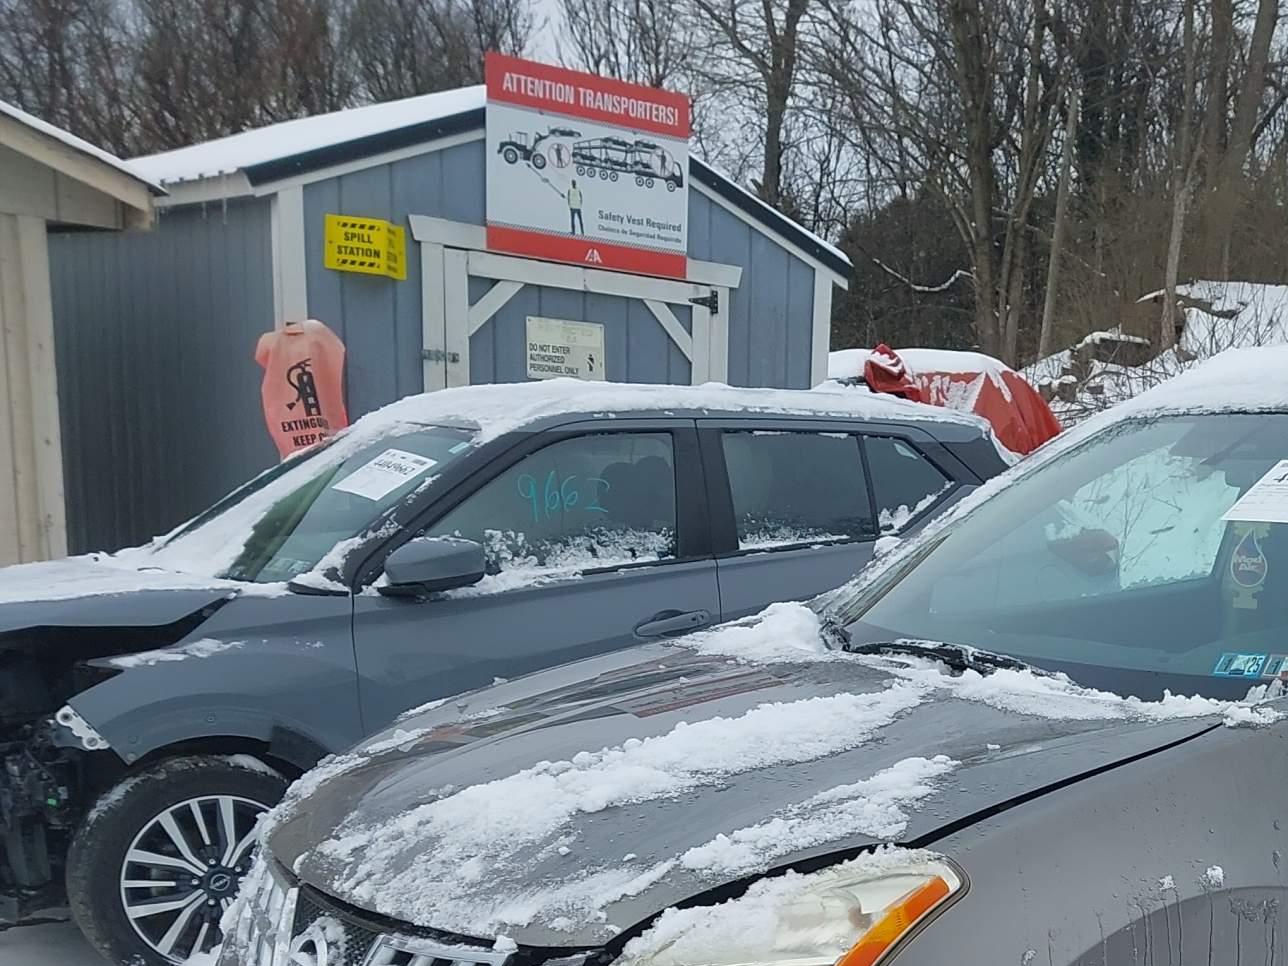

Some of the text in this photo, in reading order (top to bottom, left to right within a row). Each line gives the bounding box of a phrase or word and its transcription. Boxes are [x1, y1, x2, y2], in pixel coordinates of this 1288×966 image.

[502, 72, 679, 126] ATTENTION TRANSPORTERS!
[598, 210, 682, 232] Safety Vest Required
[343, 231, 373, 244] SPILL
[336, 244, 381, 259] STATION
[529, 342, 571, 355] DO NOT ENTER
[529, 353, 565, 364] AUTHORIZED
[529, 362, 579, 376] PERSONNEL ONLY
[292, 433, 317, 447] KEEP
